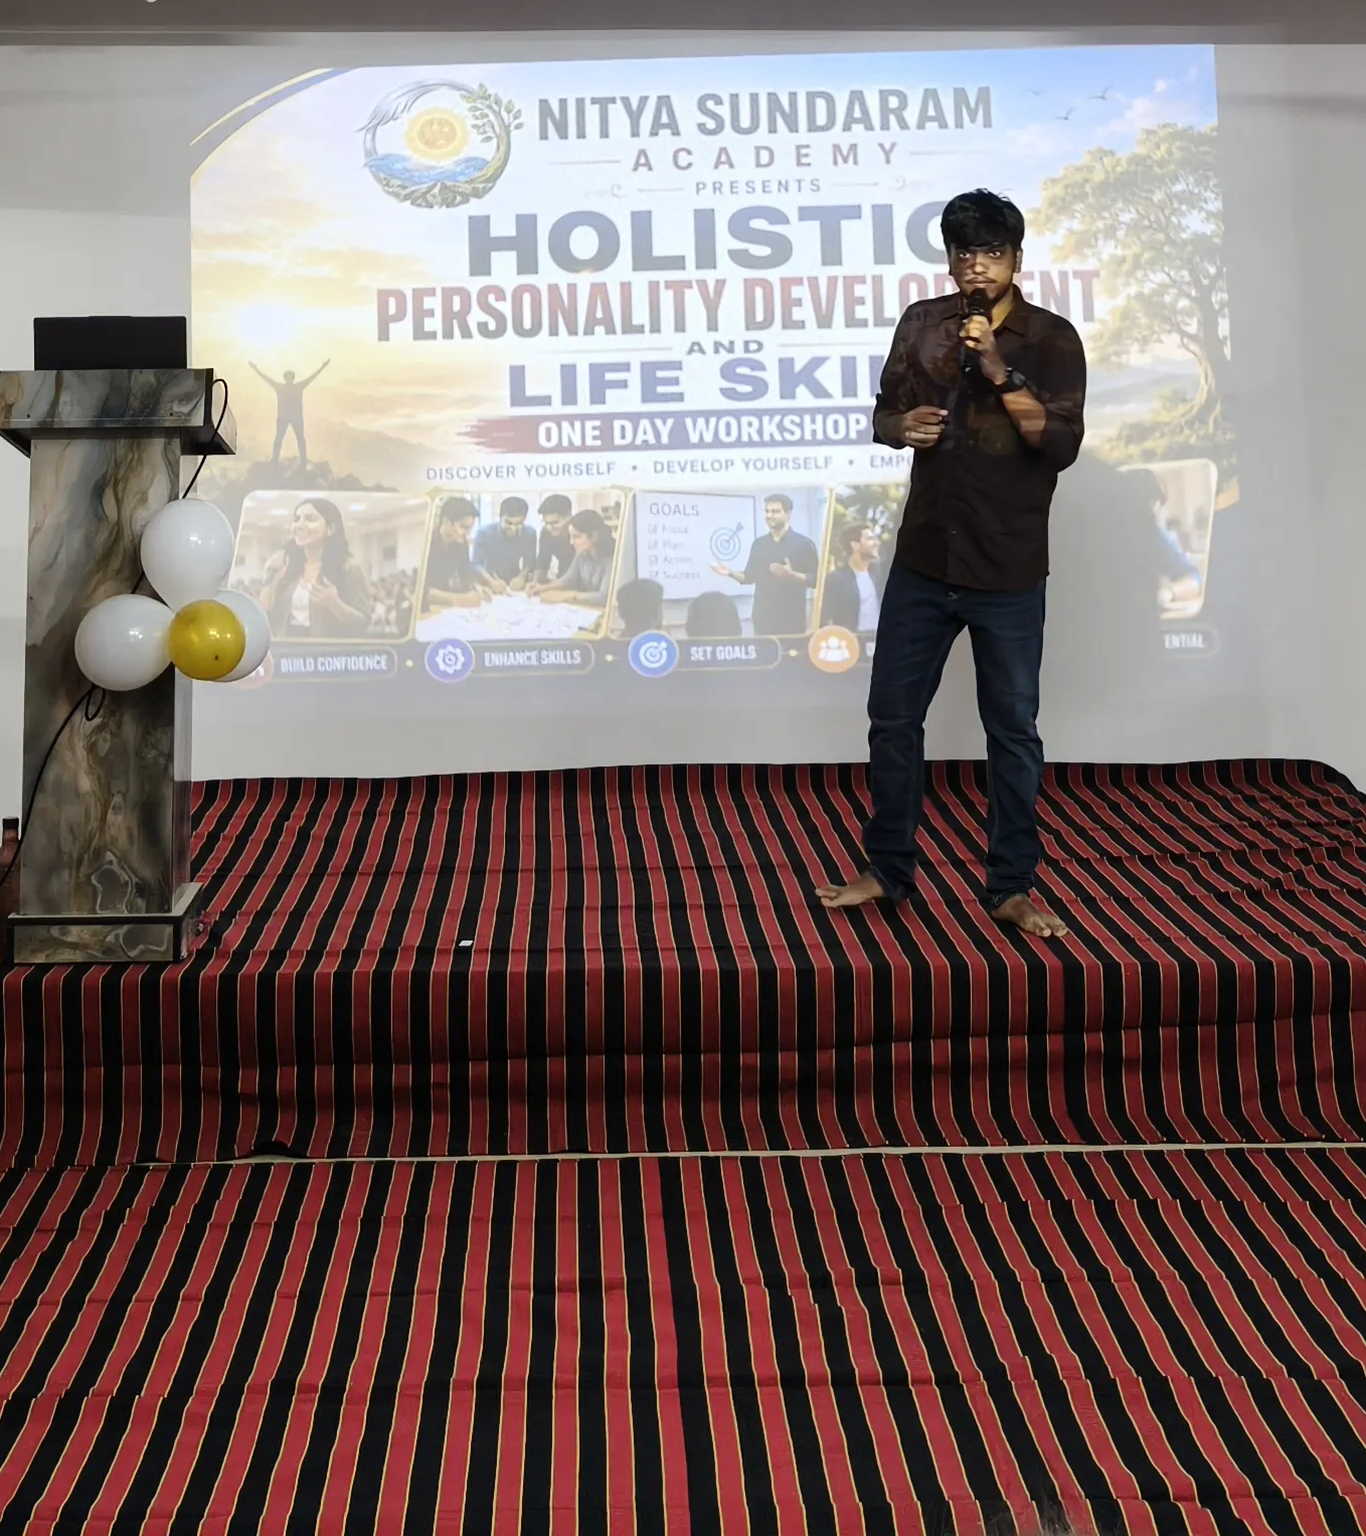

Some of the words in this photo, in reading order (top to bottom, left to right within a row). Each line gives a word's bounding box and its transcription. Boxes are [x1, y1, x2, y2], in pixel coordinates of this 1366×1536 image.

[539, 95, 680, 141] NITYA
[697, 86, 993, 136] SUNDARAM
[632, 142, 899, 172] ACADEMY
[696, 178, 822, 196] PRESENTS
[377, 277, 727, 342] PERSONALITY
[744, 270, 1100, 330] DEVELONT
[686, 339, 765, 356] AND
[509, 360, 685, 407] LIFE
[538, 421, 603, 449] ONE
[613, 417, 675, 446] DAY
[685, 414, 868, 443] WORKSHOP
[426, 464, 516, 480] DISCOVER
[525, 461, 616, 477] YOURSELF
[653, 458, 735, 474] DEVELOP
[742, 455, 833, 471] YOURSELF
[649, 502, 699, 516] GOALS
[280, 658, 314, 673] BUILD
[317, 654, 387, 672] CONFIDENCE
[484, 651, 539, 667] ENHANCE
[540, 649, 581, 665] SKILLS
[690, 646, 713, 661] SET
[716, 645, 758, 660] GOALS
